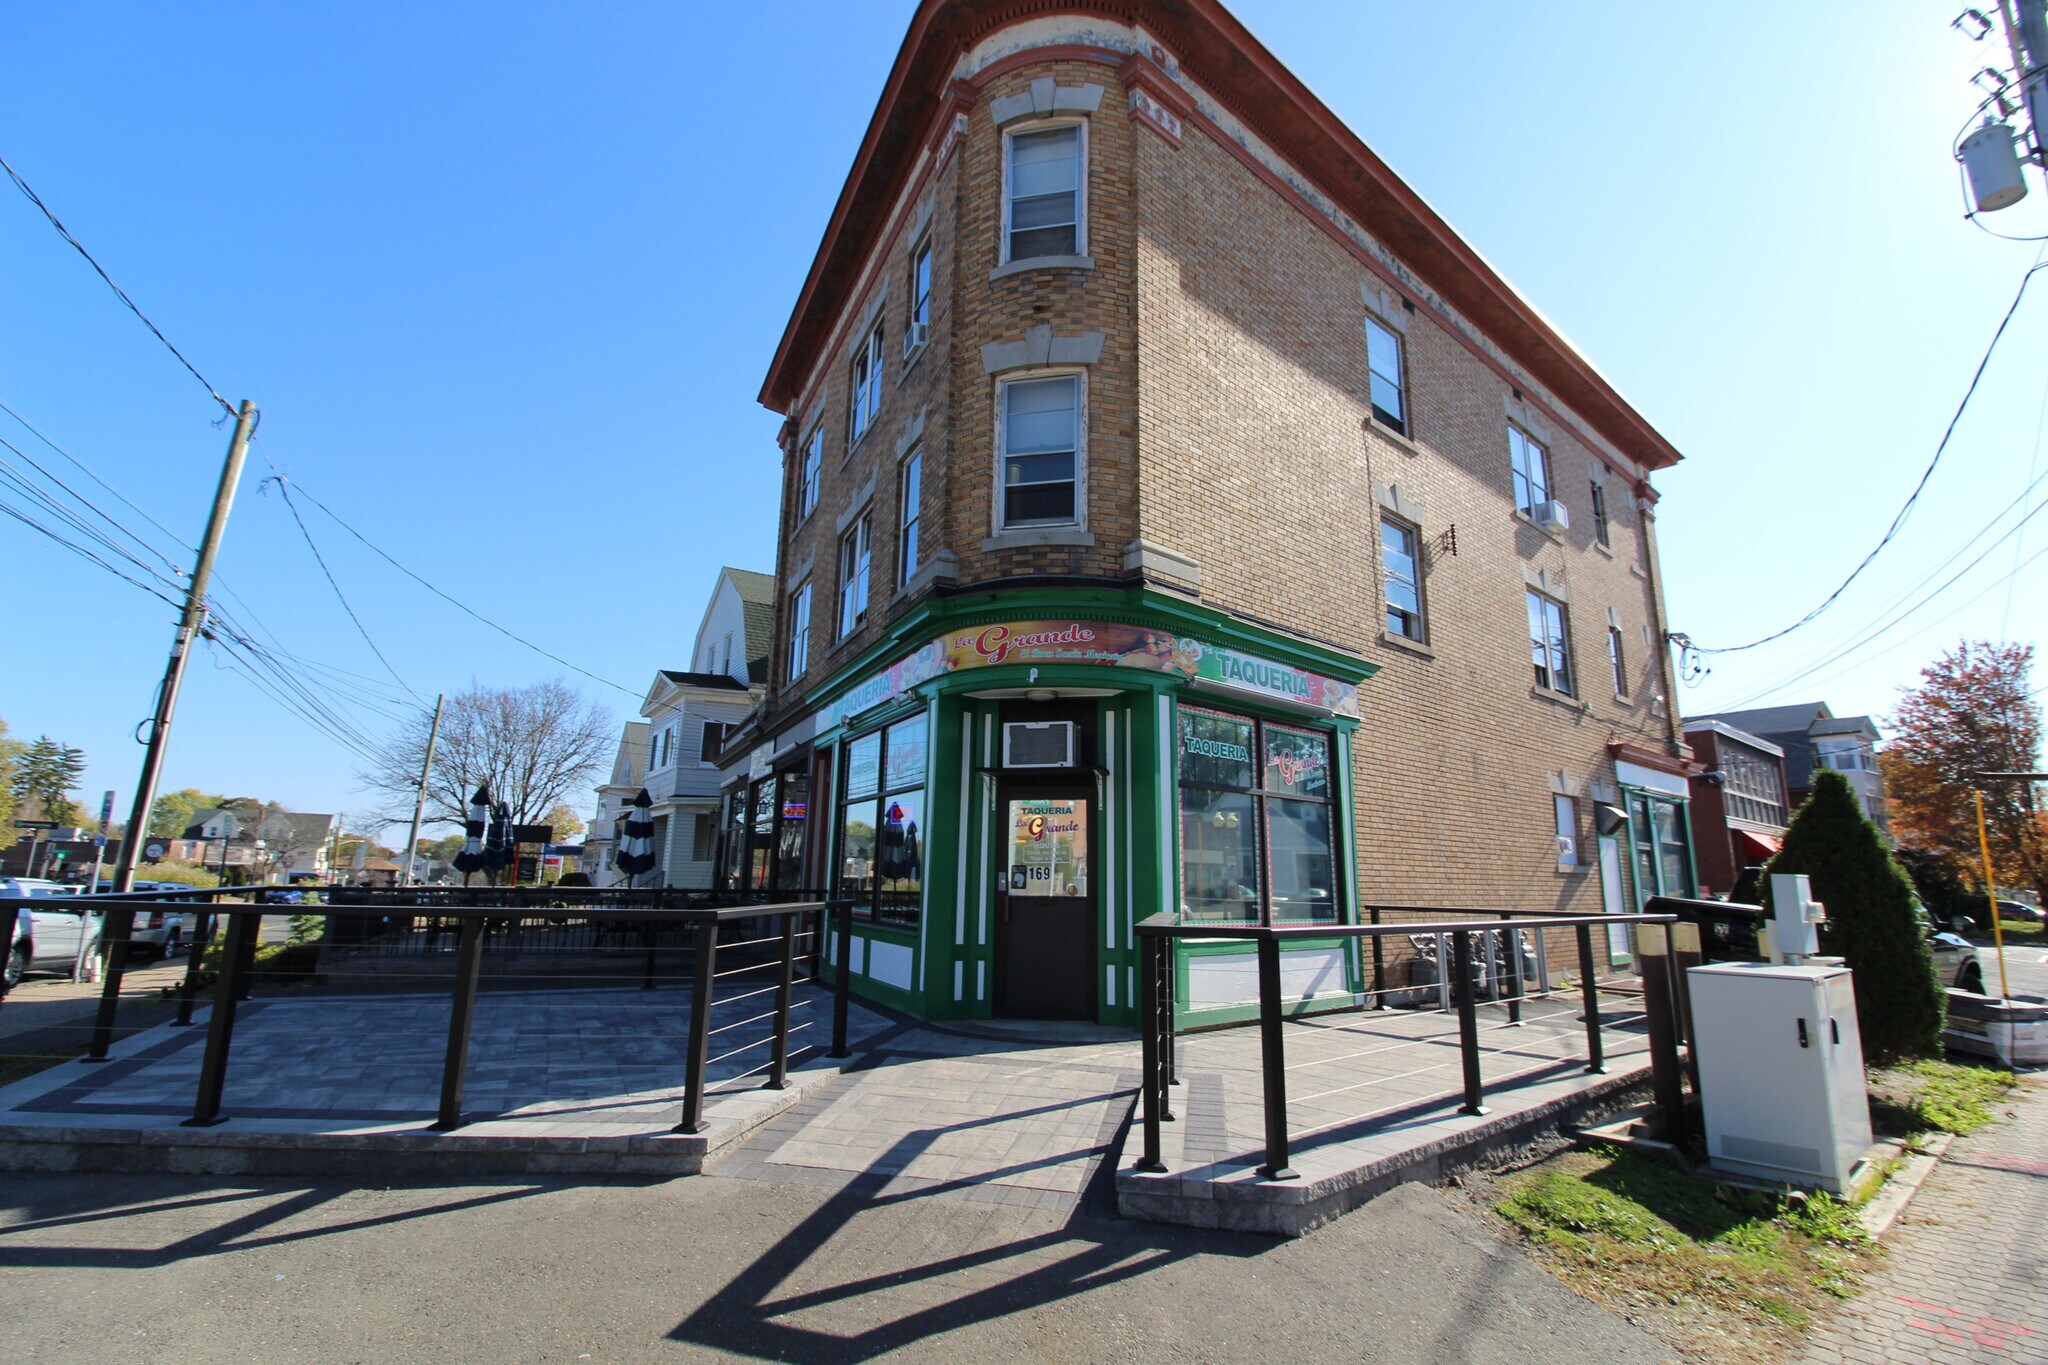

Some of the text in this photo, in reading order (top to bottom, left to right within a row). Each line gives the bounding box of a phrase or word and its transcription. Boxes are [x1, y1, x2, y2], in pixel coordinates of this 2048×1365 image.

[954, 624, 1095, 664] La Grande
[1217, 652, 1311, 698] TAQUERIA
[1185, 736, 1249, 762] TAQUERIA
[1278, 749, 1321, 785] Grande
[1021, 807, 1073, 815] TAQUERIA
[1015, 816, 1079, 842] La Grande
[1029, 867, 1050, 880] 169
